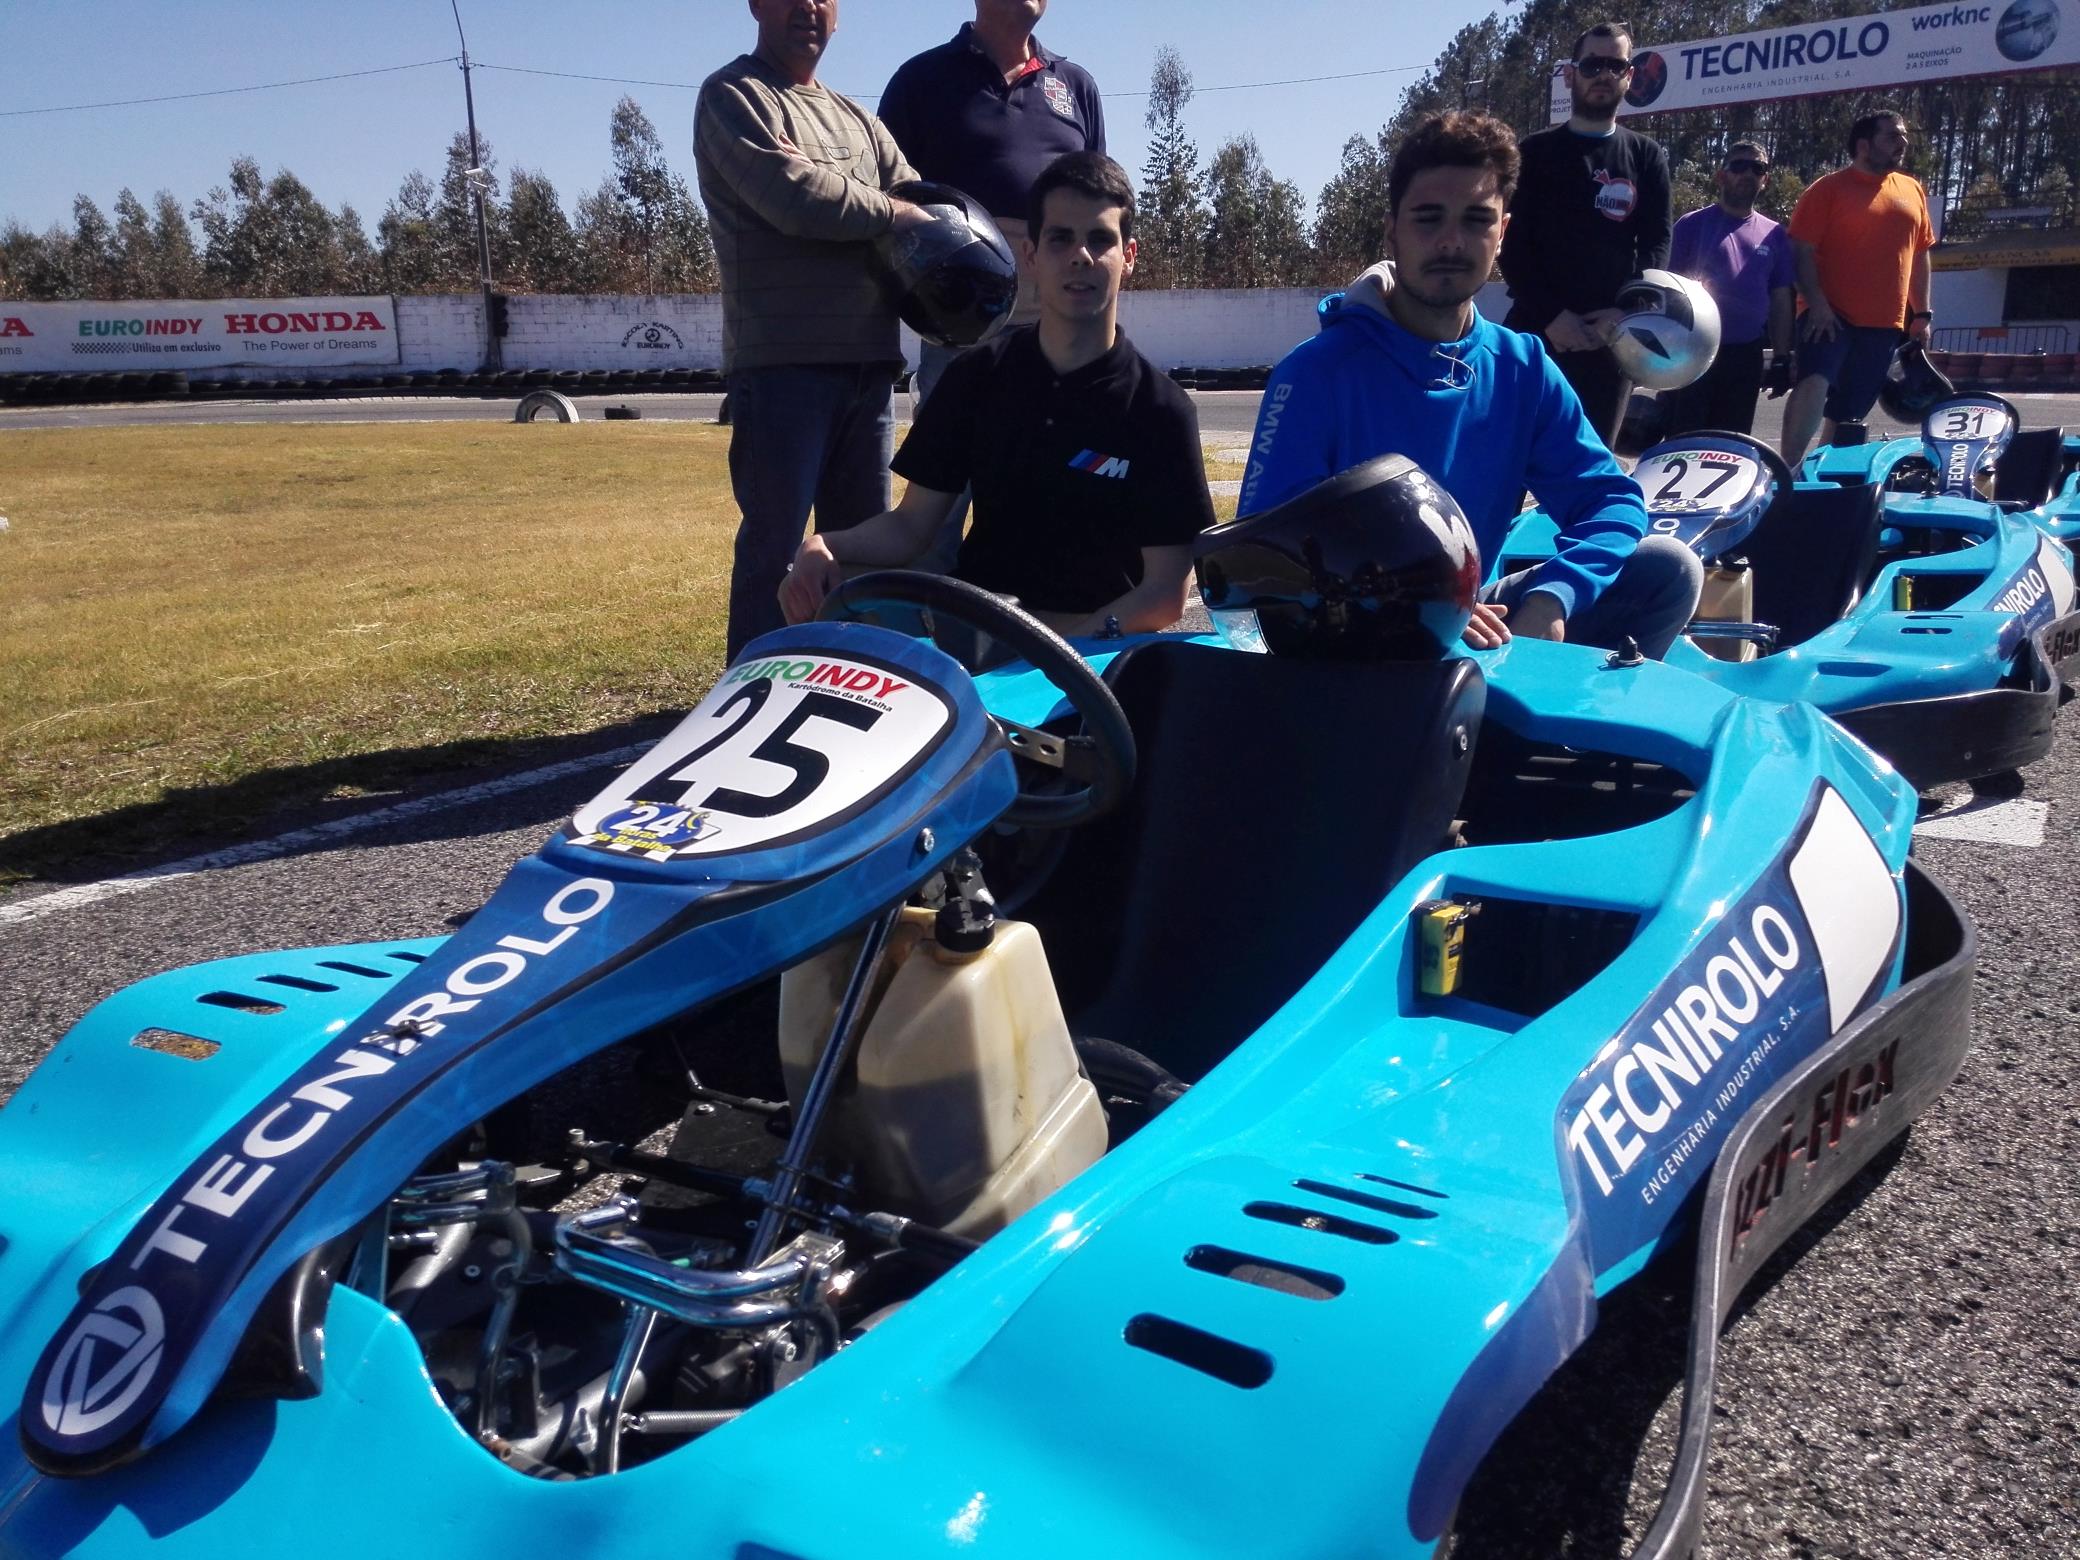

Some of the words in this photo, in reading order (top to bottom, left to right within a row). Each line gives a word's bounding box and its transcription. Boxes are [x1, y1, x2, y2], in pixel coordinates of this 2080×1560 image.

[1911, 5, 1991, 31] worknc
[1680, 21, 1890, 81] TECNIROLO
[1702, 80, 1763, 96] ENGENHARIA
[79, 318, 203, 337] EUROINDY
[224, 311, 386, 334] HONDA
[132, 342, 161, 353] Utiliza
[164, 344, 178, 353] em
[180, 341, 221, 352] exclusivo
[242, 340, 267, 351] The
[271, 340, 309, 351] Power
[313, 339, 325, 350] of
[328, 338, 377, 350] Dreams
[1257, 383, 1293, 455] BMW
[1945, 412, 1984, 435] 31
[1651, 452, 1743, 467] EUROINDY
[1654, 458, 1741, 499] 27
[723, 660, 909, 699] EUROINDY
[788, 682, 841, 697] Kartódromo
[841, 690, 854, 700] da
[855, 694, 893, 712] Batalha
[625, 677, 884, 819] 25
[609, 805, 693, 838] 24
[612, 834, 673, 853] Batalha
[1568, 904, 1801, 1197] TECNIROLO
[1640, 1109, 1718, 1205] ENGENHARIA
